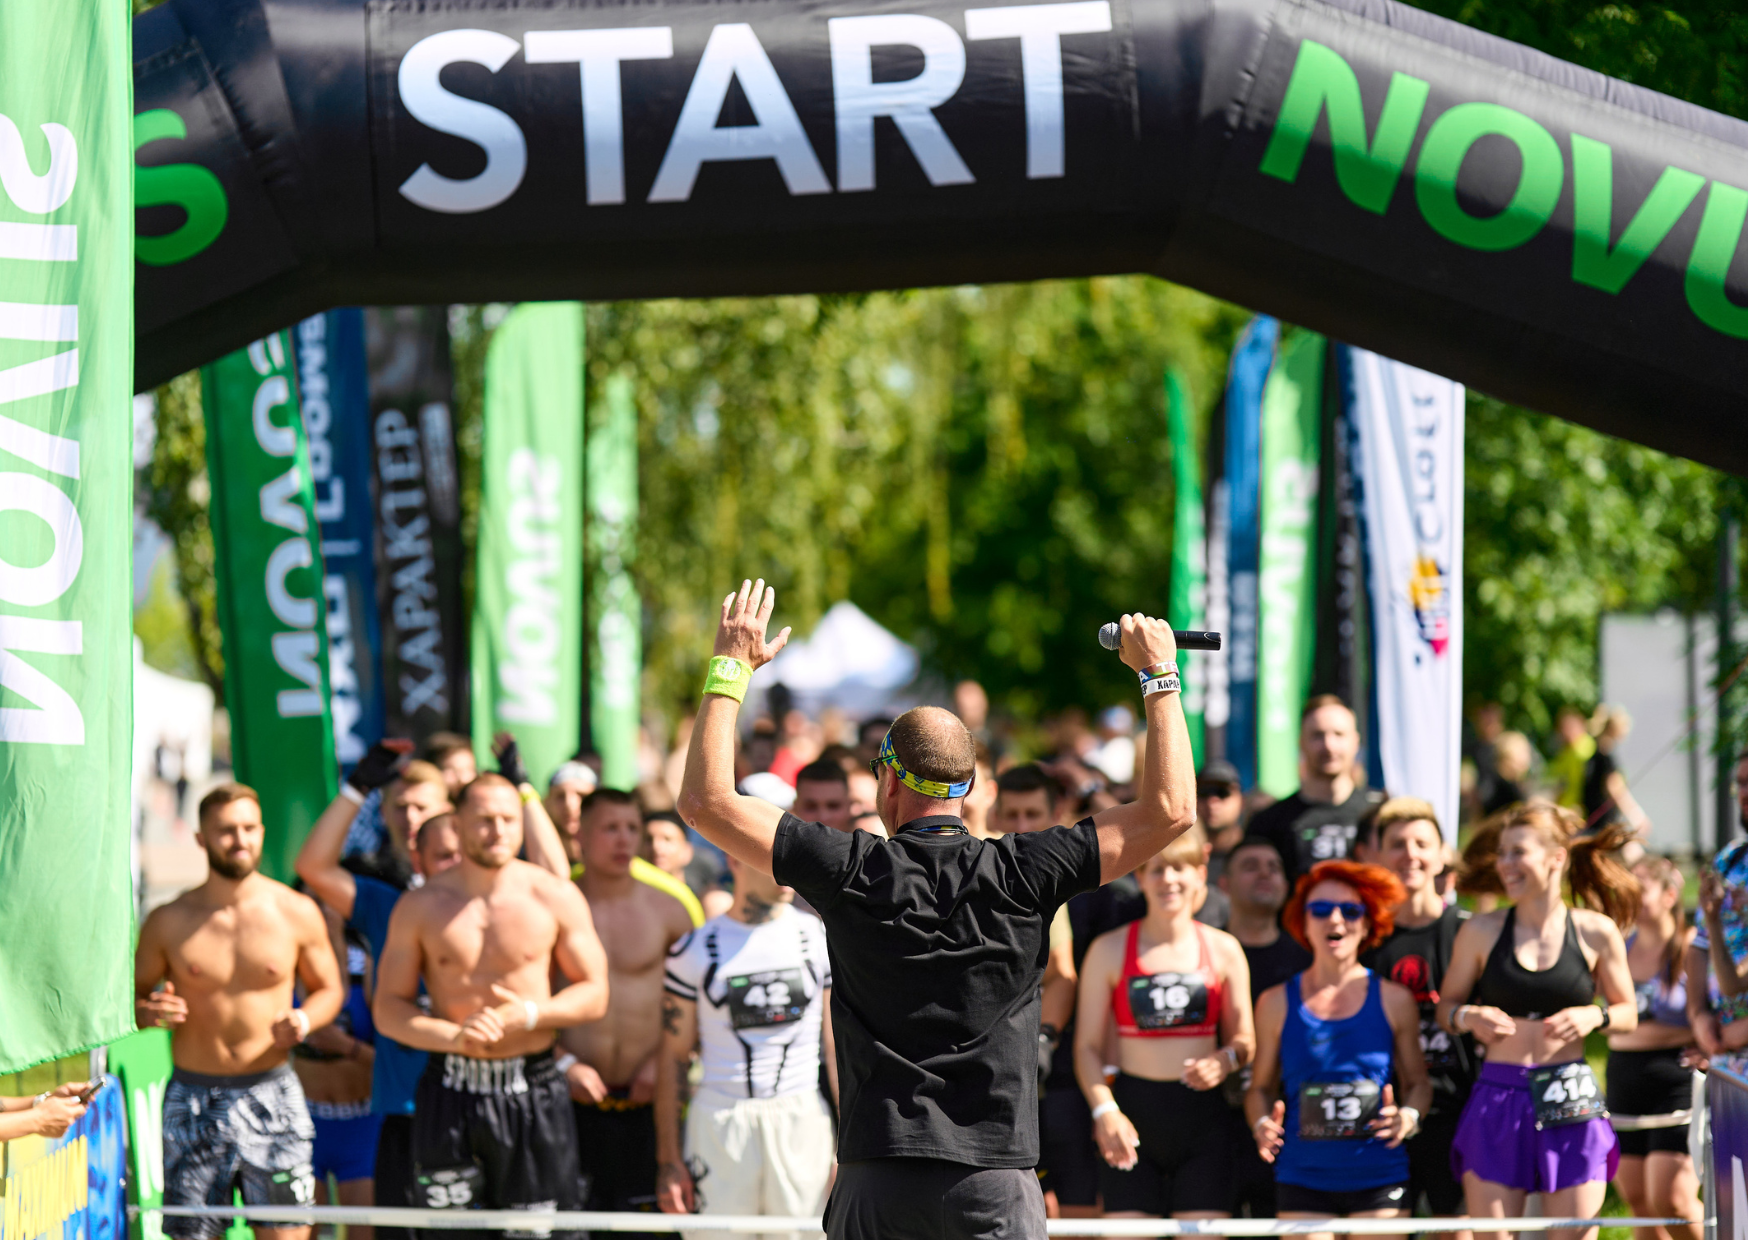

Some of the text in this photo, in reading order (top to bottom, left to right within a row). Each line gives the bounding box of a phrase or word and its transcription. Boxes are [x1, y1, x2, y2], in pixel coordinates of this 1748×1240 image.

[398, 1, 1113, 214] START
[374, 406, 450, 718] ХАРАКТЕР
[743, 981, 792, 1008] 42
[1149, 985, 1190, 1010] 16
[1542, 1074, 1597, 1103] 414
[1320, 1096, 1362, 1120] 13
[426, 1180, 473, 1209] 35
